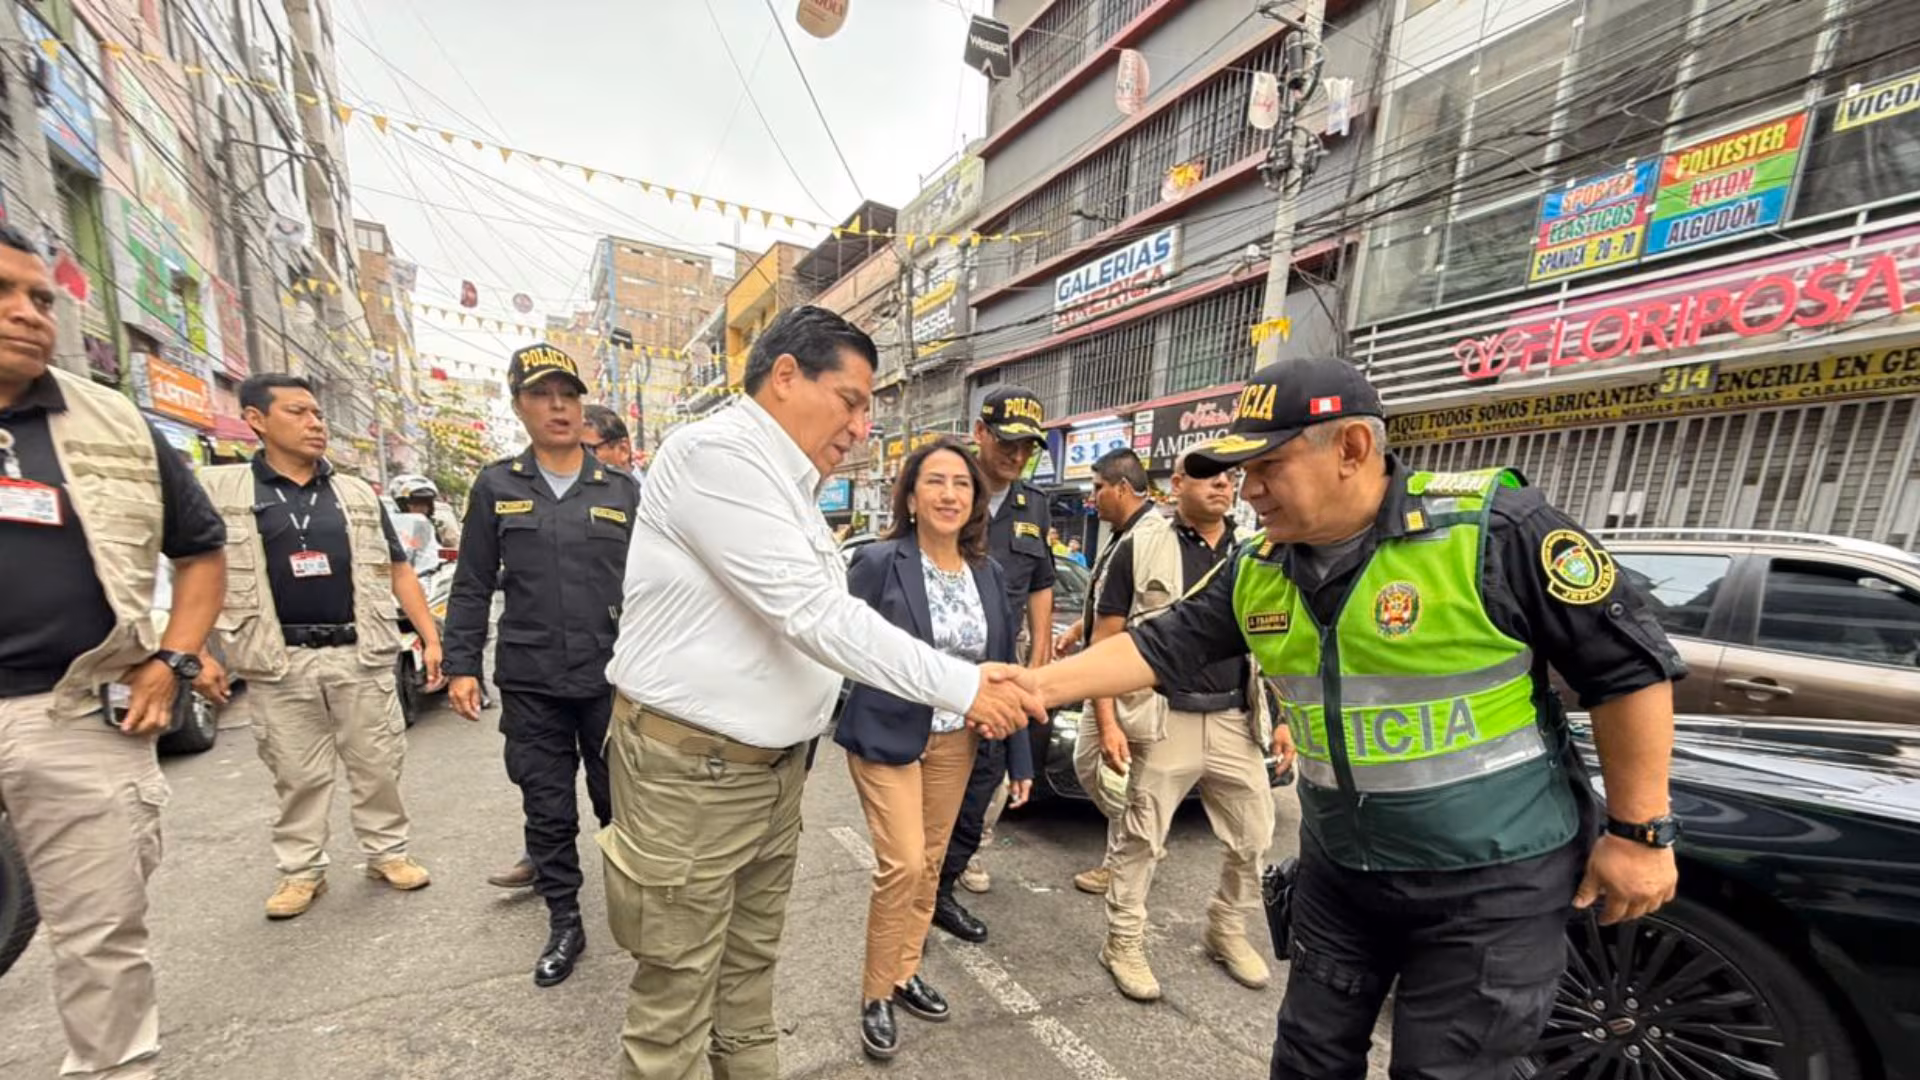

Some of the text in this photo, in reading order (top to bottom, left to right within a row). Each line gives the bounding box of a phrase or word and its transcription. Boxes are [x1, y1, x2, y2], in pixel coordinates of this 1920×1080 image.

[1848, 82, 1920, 120] VICO
[1676, 122, 1787, 178] POLYESTER
[1690, 168, 1755, 207] NYLON
[1058, 230, 1171, 302] GALERIAS
[1516, 254, 1907, 373] FLORIPOSA
[1660, 364, 1711, 395] 314
[1716, 360, 1820, 394] ENCERIA
[1832, 353, 1874, 379] EN
[1234, 384, 1277, 421] ICIA
[1427, 407, 1473, 429] TODOS
[1478, 399, 1528, 421] SOMOS
[1534, 382, 1660, 416] FABRICANTES
[1284, 697, 1477, 758] LICIA
